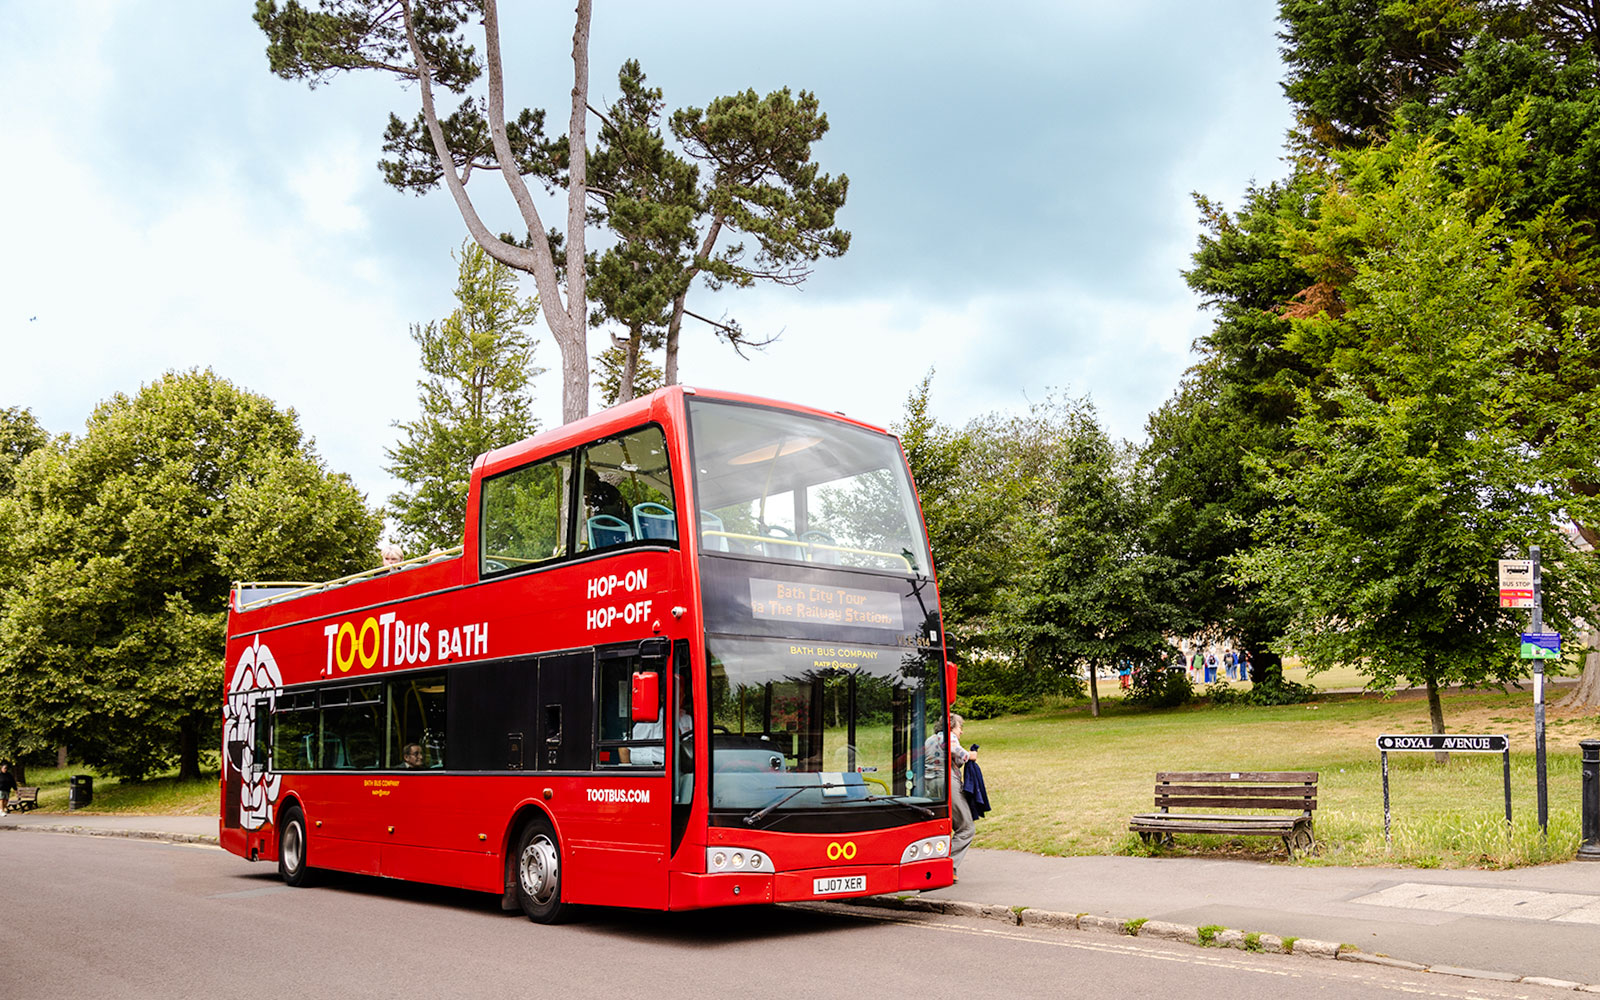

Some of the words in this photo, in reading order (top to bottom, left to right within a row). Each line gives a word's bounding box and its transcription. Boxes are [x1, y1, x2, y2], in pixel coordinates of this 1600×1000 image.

[587, 568, 648, 599] HOP-ON
[776, 583, 806, 600] Bath
[809, 587, 833, 604] City
[836, 589, 867, 605] Tour
[586, 600, 653, 630] HOP-OFF
[767, 600, 793, 616] The
[796, 602, 843, 622] Railway
[438, 622, 489, 660] BATH
[790, 645, 814, 655] BATH
[816, 647, 836, 657] BUS
[837, 649, 879, 659] COMPANY
[1394, 738, 1434, 748] ROYAL
[1441, 738, 1491, 749] AVENUE
[586, 788, 650, 803] TOOTBUS.COM
[817, 879, 842, 892] LJ07
[844, 878, 863, 890] XER
